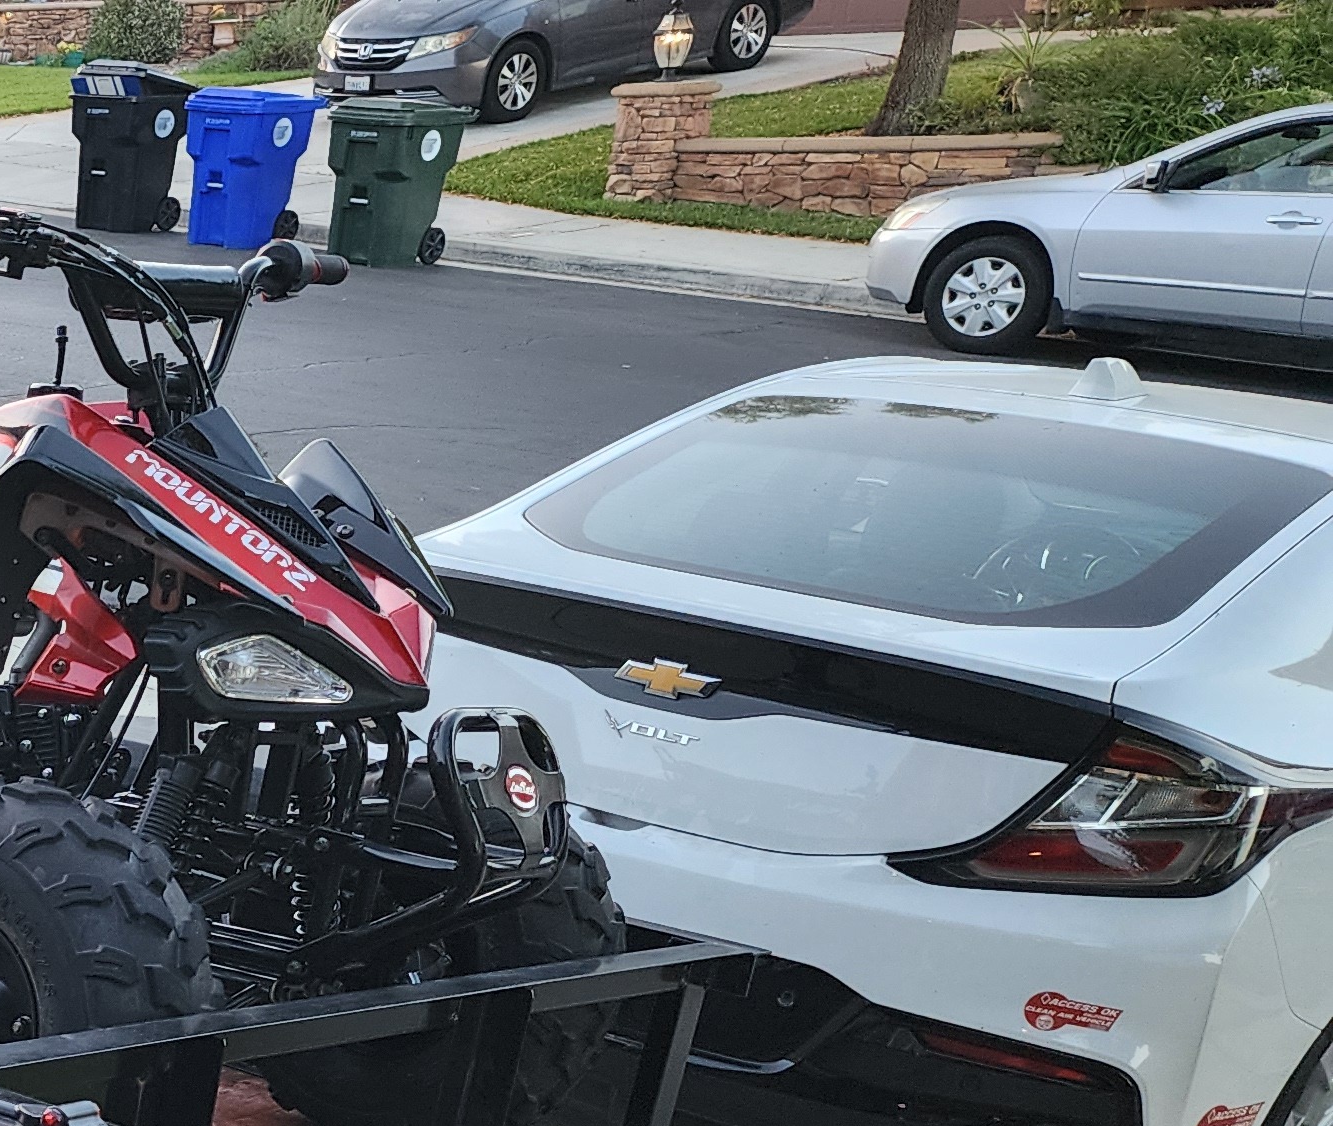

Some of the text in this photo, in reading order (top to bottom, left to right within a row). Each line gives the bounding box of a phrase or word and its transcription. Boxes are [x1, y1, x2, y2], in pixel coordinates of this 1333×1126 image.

[604, 709, 701, 746] VOLT
[1025, 1005, 1057, 1016] CLEAN
[1057, 1012, 1075, 1020] AIR
[1076, 1015, 1113, 1027] VEHICLE
[1049, 998, 1120, 1018] ACCESS OK
